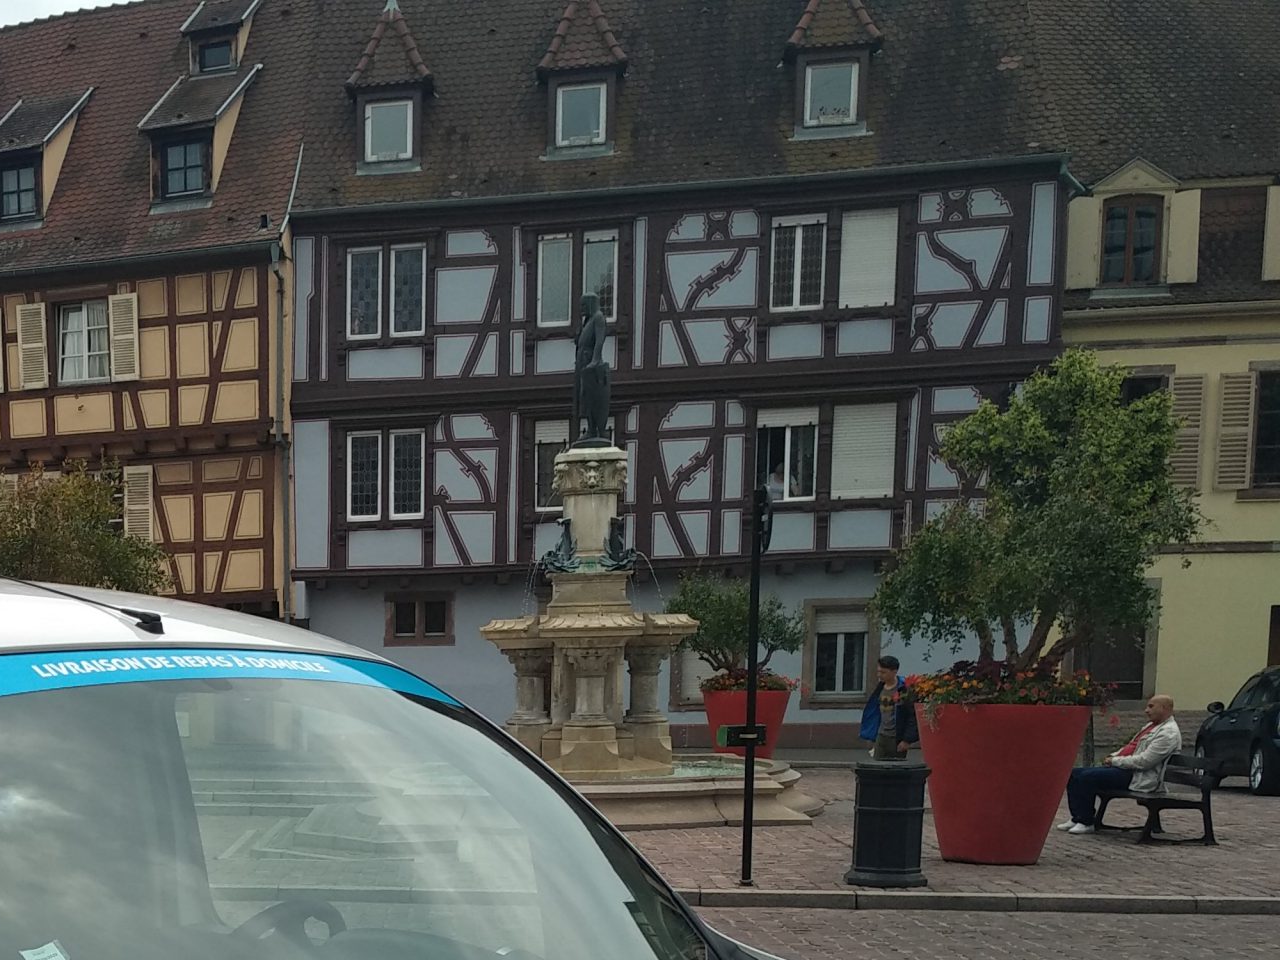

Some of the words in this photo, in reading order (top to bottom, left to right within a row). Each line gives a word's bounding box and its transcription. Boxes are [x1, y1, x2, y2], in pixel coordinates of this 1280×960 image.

[31, 656, 142, 678] LIVRAISON
[143, 655, 172, 670] DE
[172, 655, 233, 669] REPAS
[231, 653, 247, 668] À
[246, 658, 330, 673] DOMICILE
